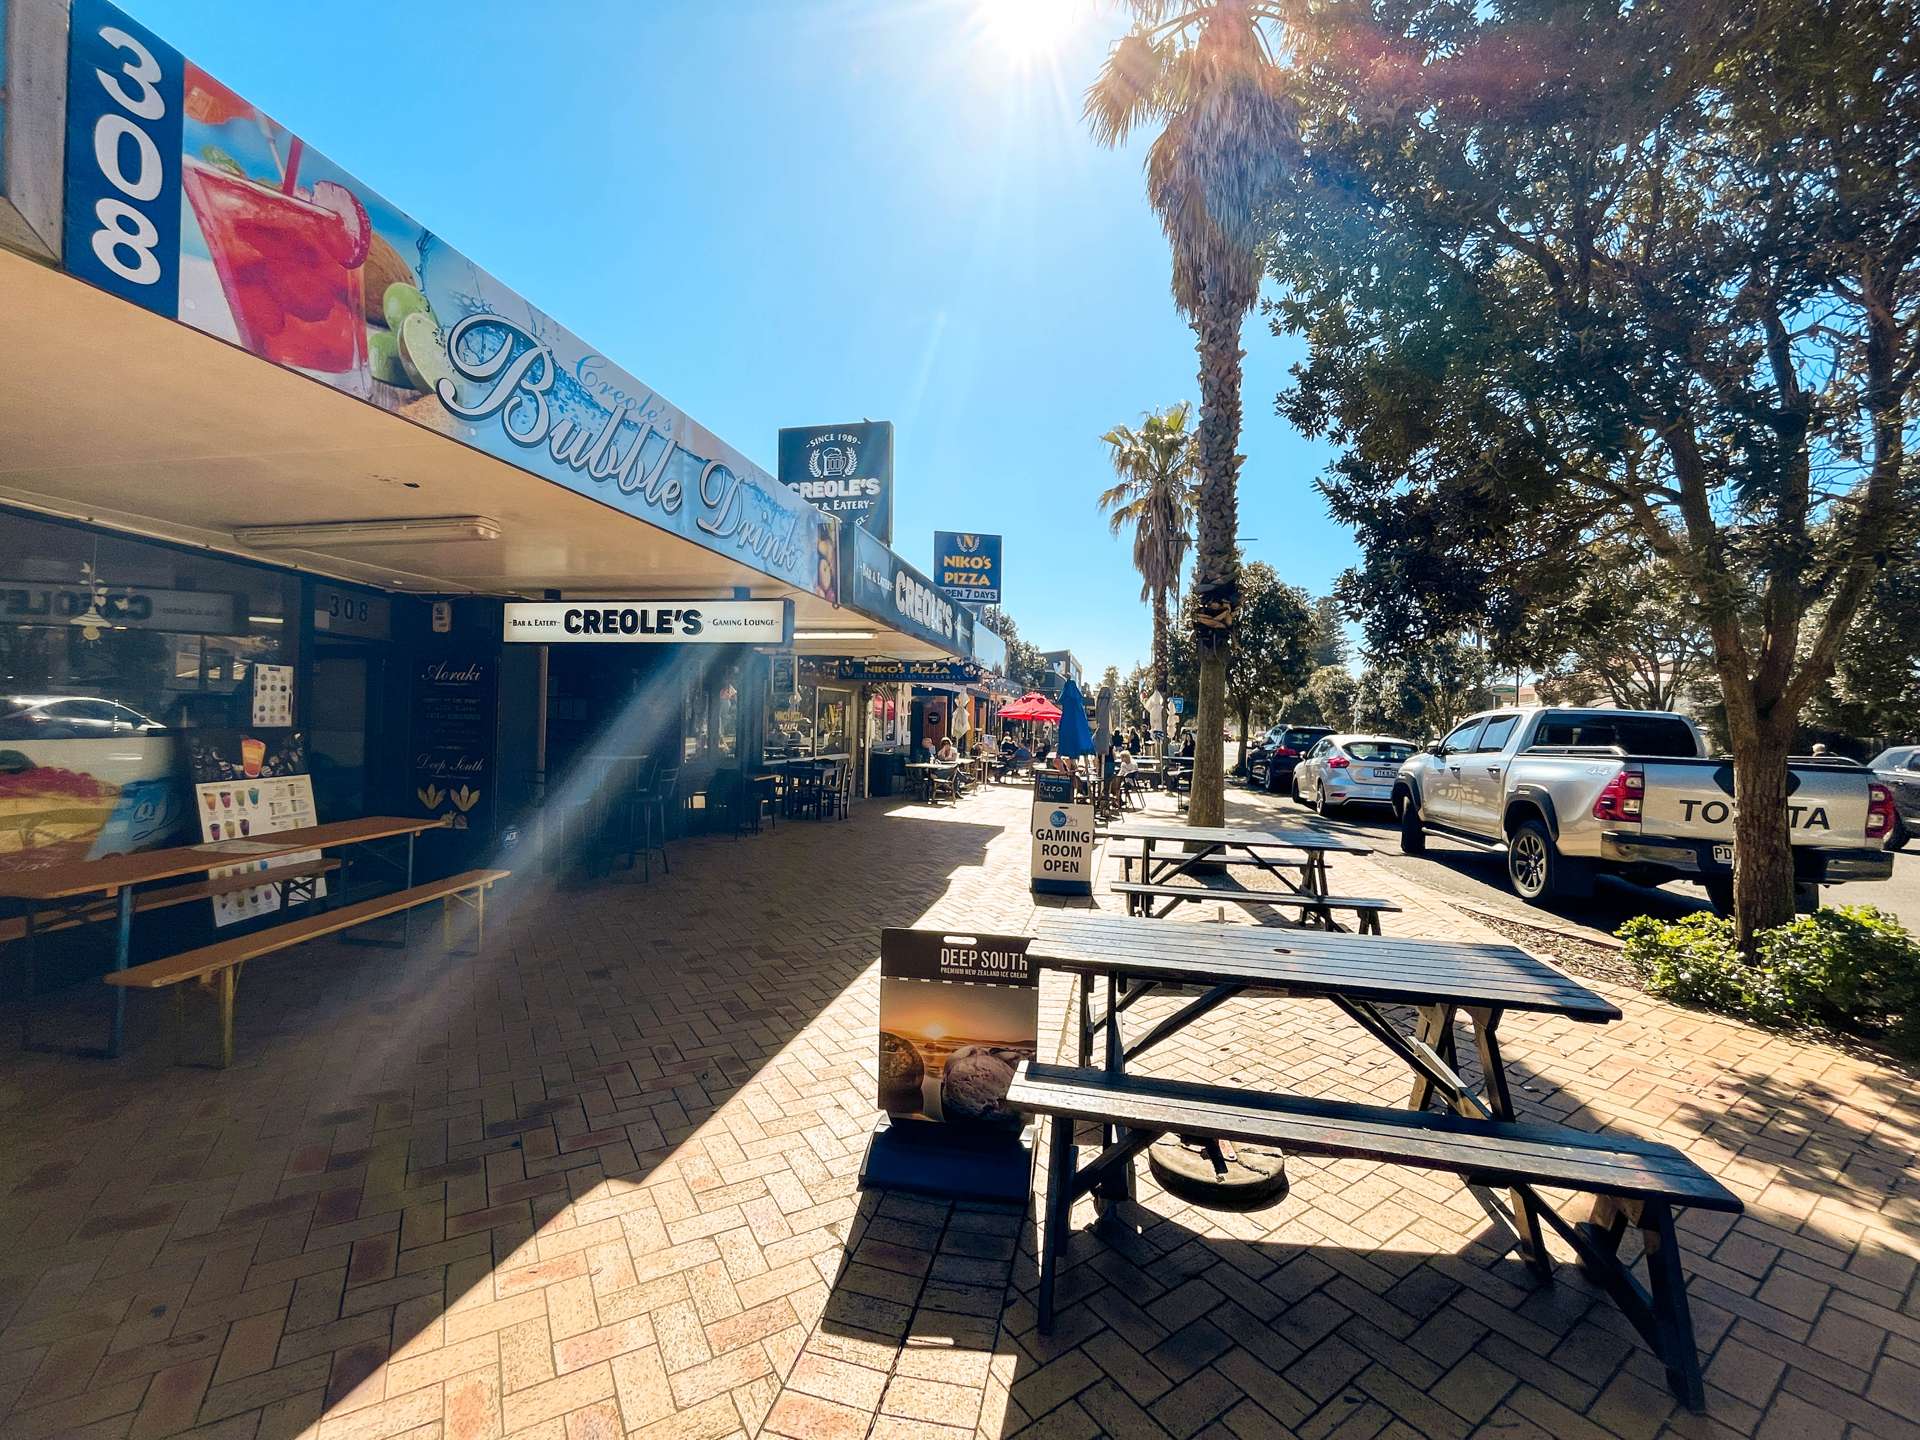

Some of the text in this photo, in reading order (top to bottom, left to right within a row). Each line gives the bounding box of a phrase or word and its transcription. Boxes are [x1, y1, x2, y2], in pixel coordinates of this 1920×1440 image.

[92, 26, 166, 285] 308
[574, 354, 673, 432] Creole's
[436, 313, 801, 573] Bubble Drink
[822, 502, 832, 511] &
[944, 572, 991, 586] PIZZA
[945, 589, 997, 600] PEN 7 DAYS
[895, 570, 953, 640] CREOLE'S
[564, 608, 703, 636] CREOLE'S
[421, 660, 484, 681] Aoraki
[864, 665, 950, 674] NIKOS PIZZA
[1040, 781, 1063, 793] Pizza
[1679, 799, 1830, 831] TOTA
[1036, 828, 1090, 843] GAMING
[1042, 844, 1082, 858] ROOM
[1043, 859, 1079, 873] OPEN
[941, 948, 978, 967] DEEP
[941, 966, 964, 975] PREMIUM
[965, 968, 976, 976] NEW
[977, 969, 1000, 977] ZEALAND
